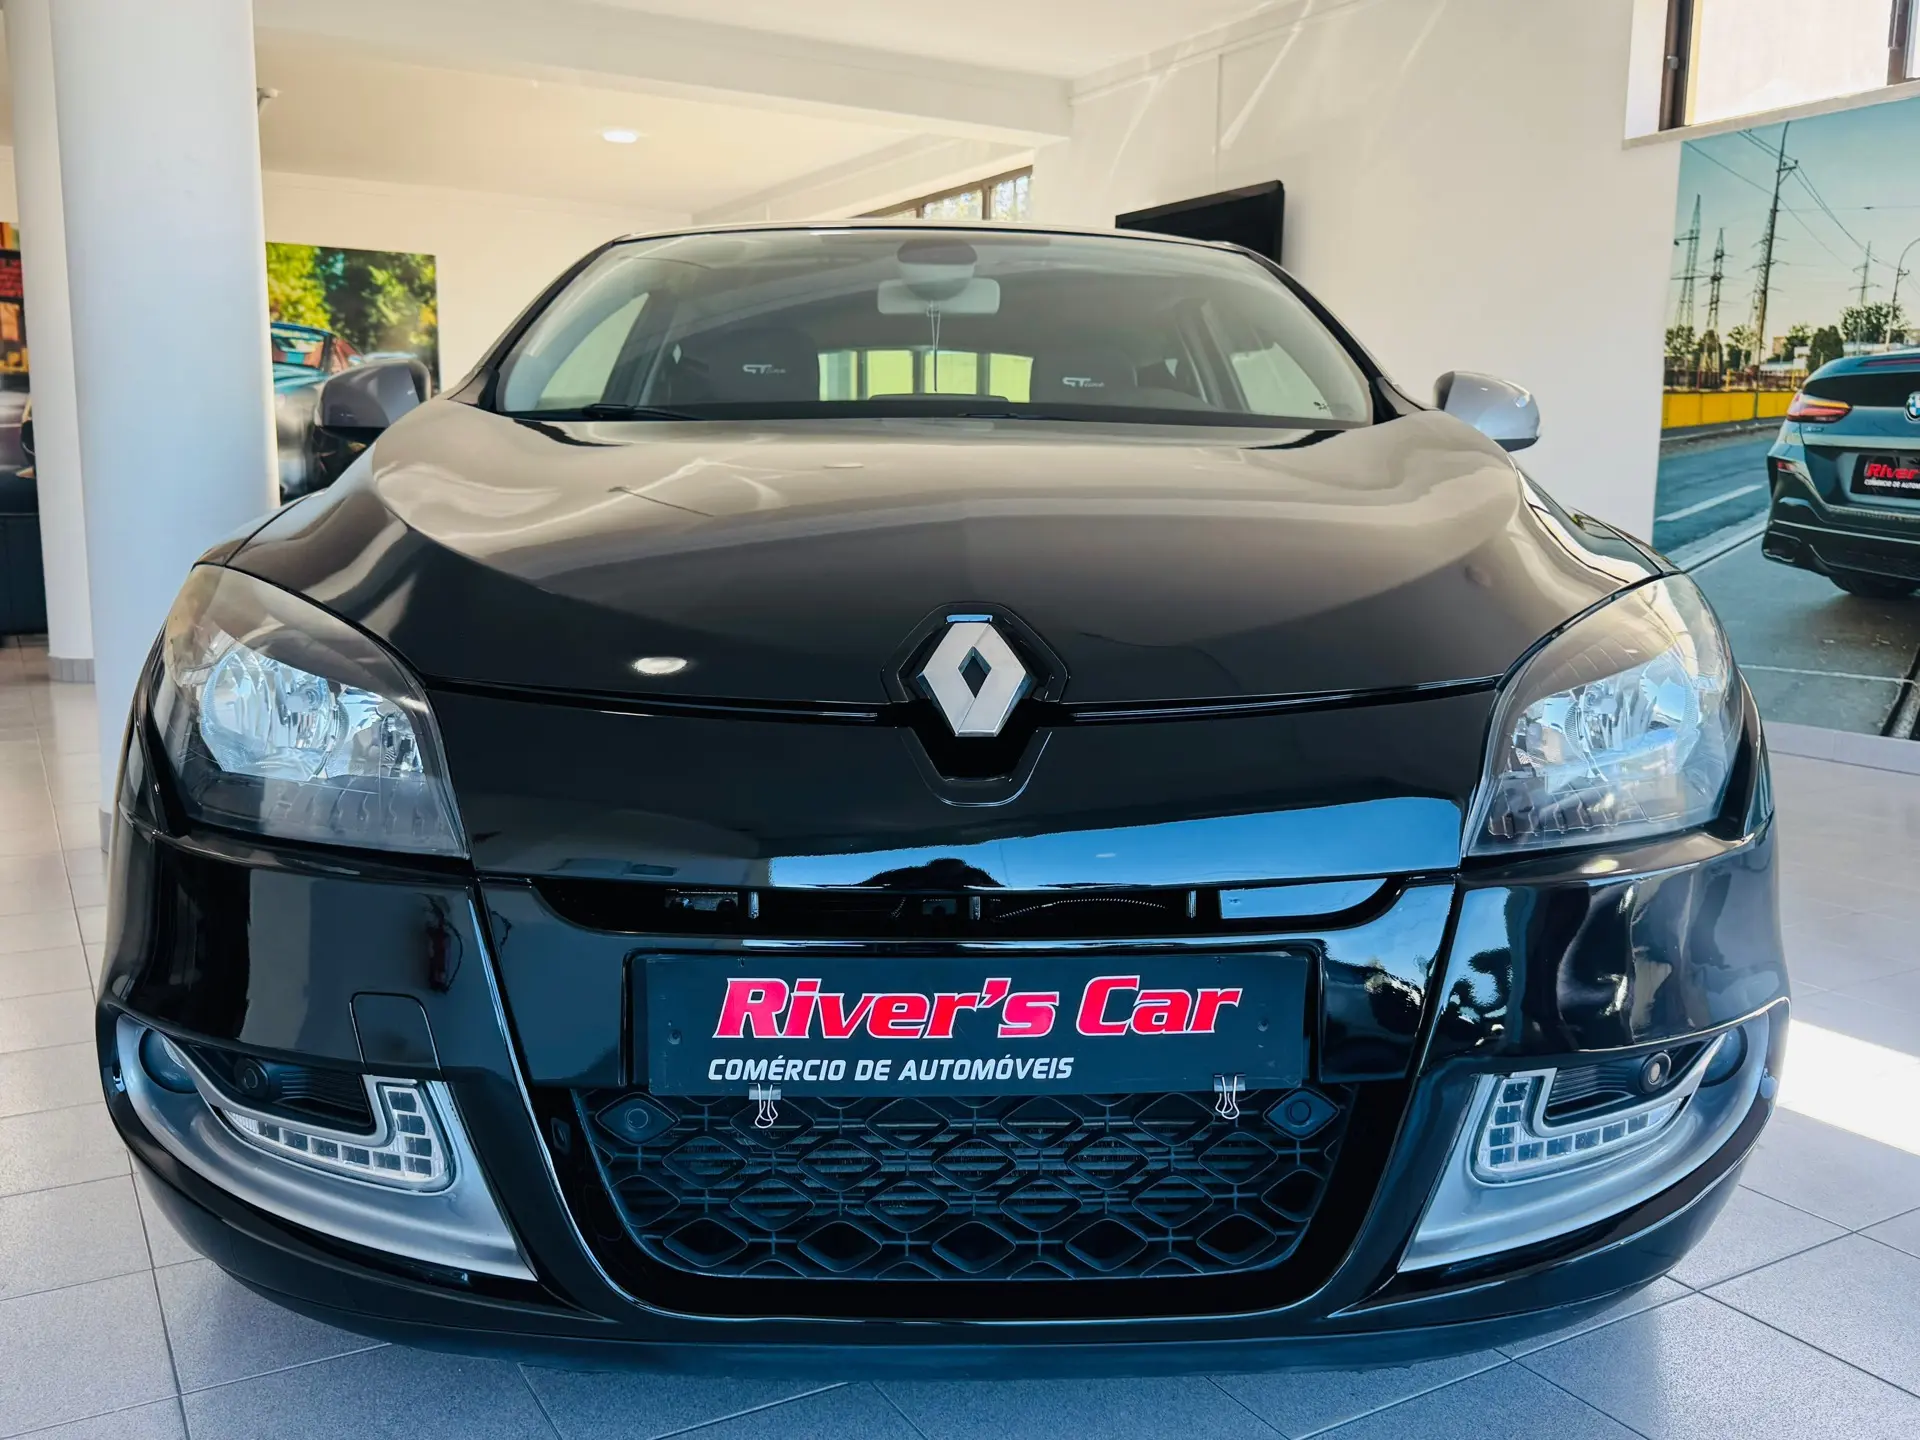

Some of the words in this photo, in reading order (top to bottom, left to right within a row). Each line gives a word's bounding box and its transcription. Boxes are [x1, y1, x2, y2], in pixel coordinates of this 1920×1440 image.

[712, 978, 1059, 1038] River's
[1076, 975, 1243, 1036] Car
[708, 1055, 846, 1081] COMÉRCIO
[854, 1059, 892, 1081] DE
[898, 1054, 1074, 1081] AUTOMÓVEIS
